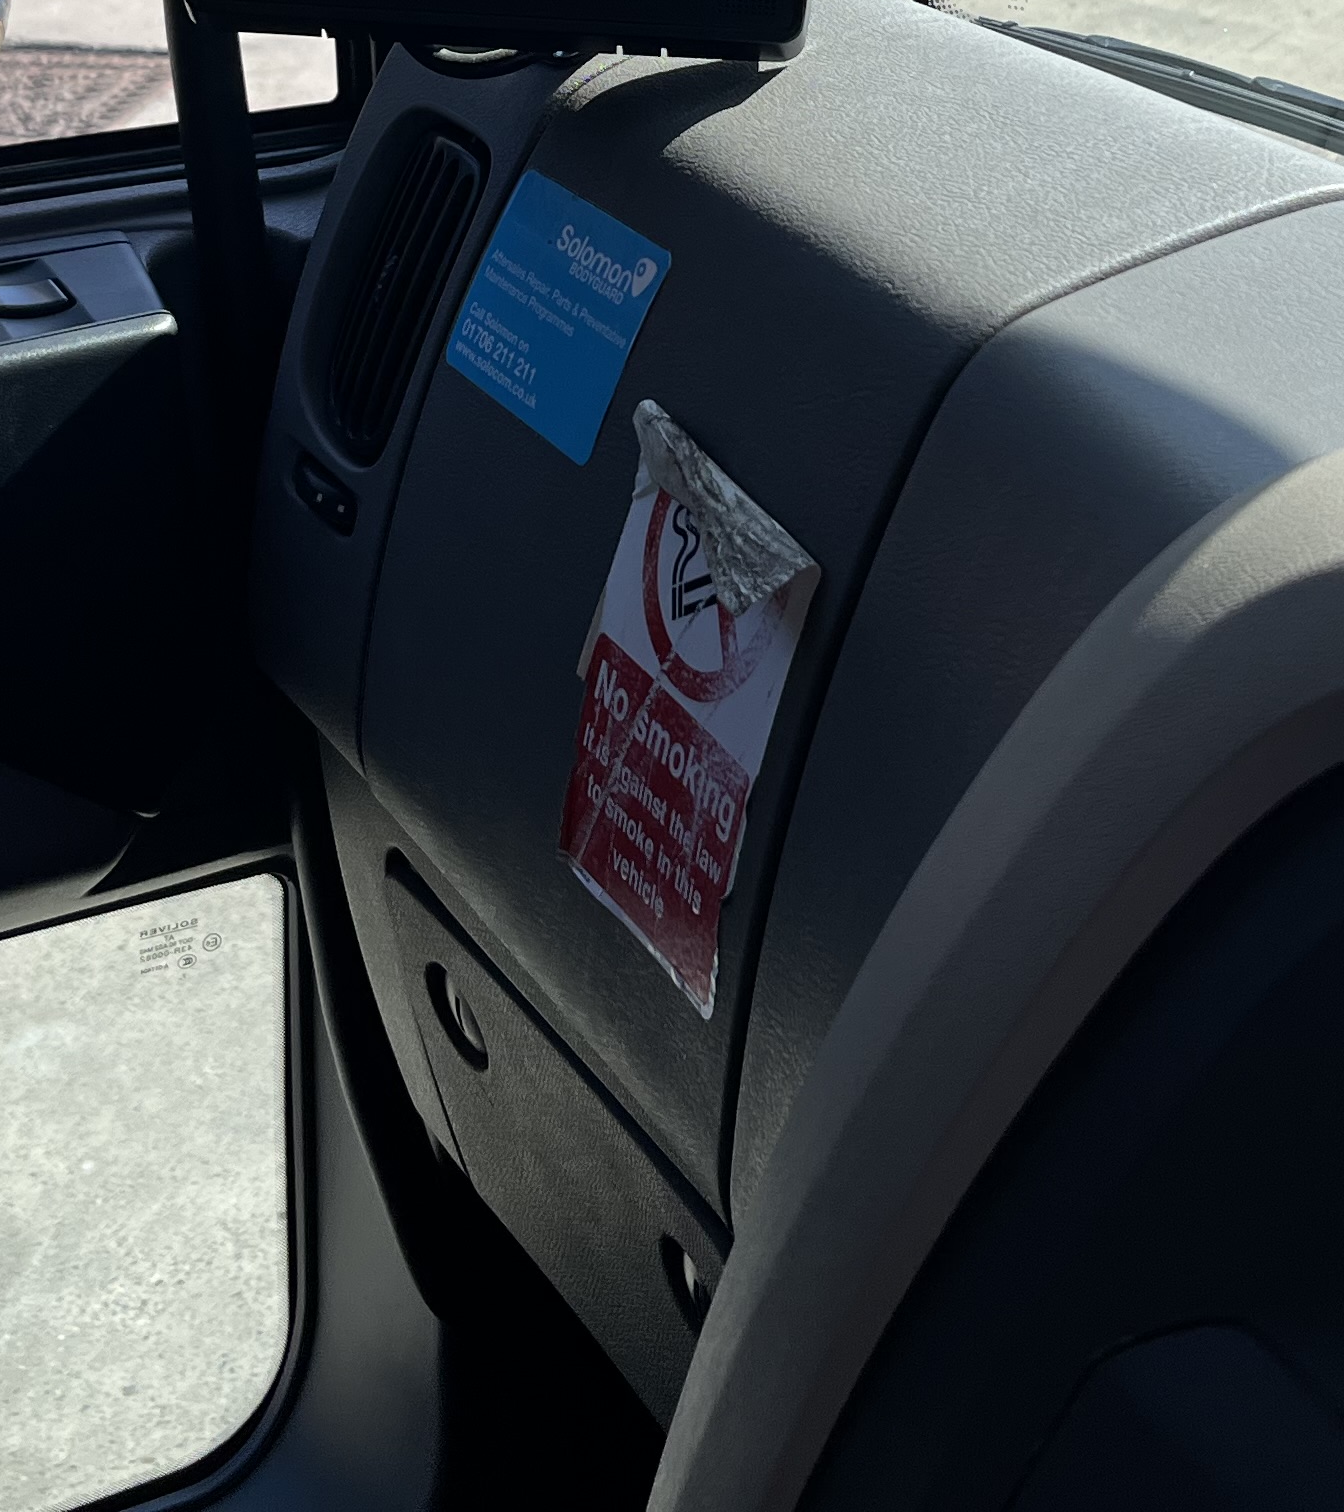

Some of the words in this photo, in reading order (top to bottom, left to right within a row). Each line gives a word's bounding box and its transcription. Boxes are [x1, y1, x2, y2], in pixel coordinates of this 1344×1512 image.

[556, 224, 633, 294] Solomon
[568, 261, 624, 305] BODYGUARD
[469, 301, 485, 321] Call
[484, 312, 518, 346] Solomon
[517, 338, 530, 353] on
[552, 288, 572, 312] Parts
[461, 317, 495, 354] 01706
[492, 341, 515, 368] 211
[513, 356, 537, 385] 211
[593, 659, 630, 722] No
[631, 710, 737, 843] smoking
[583, 721, 596, 750] It
[594, 735, 610, 767] is
[669, 808, 693, 851] the
[695, 837, 722, 885] law
[587, 773, 601, 802] to
[605, 796, 655, 862] smoke
[657, 843, 672, 879] in
[674, 863, 703, 916] this
[611, 846, 666, 920] vehicle
